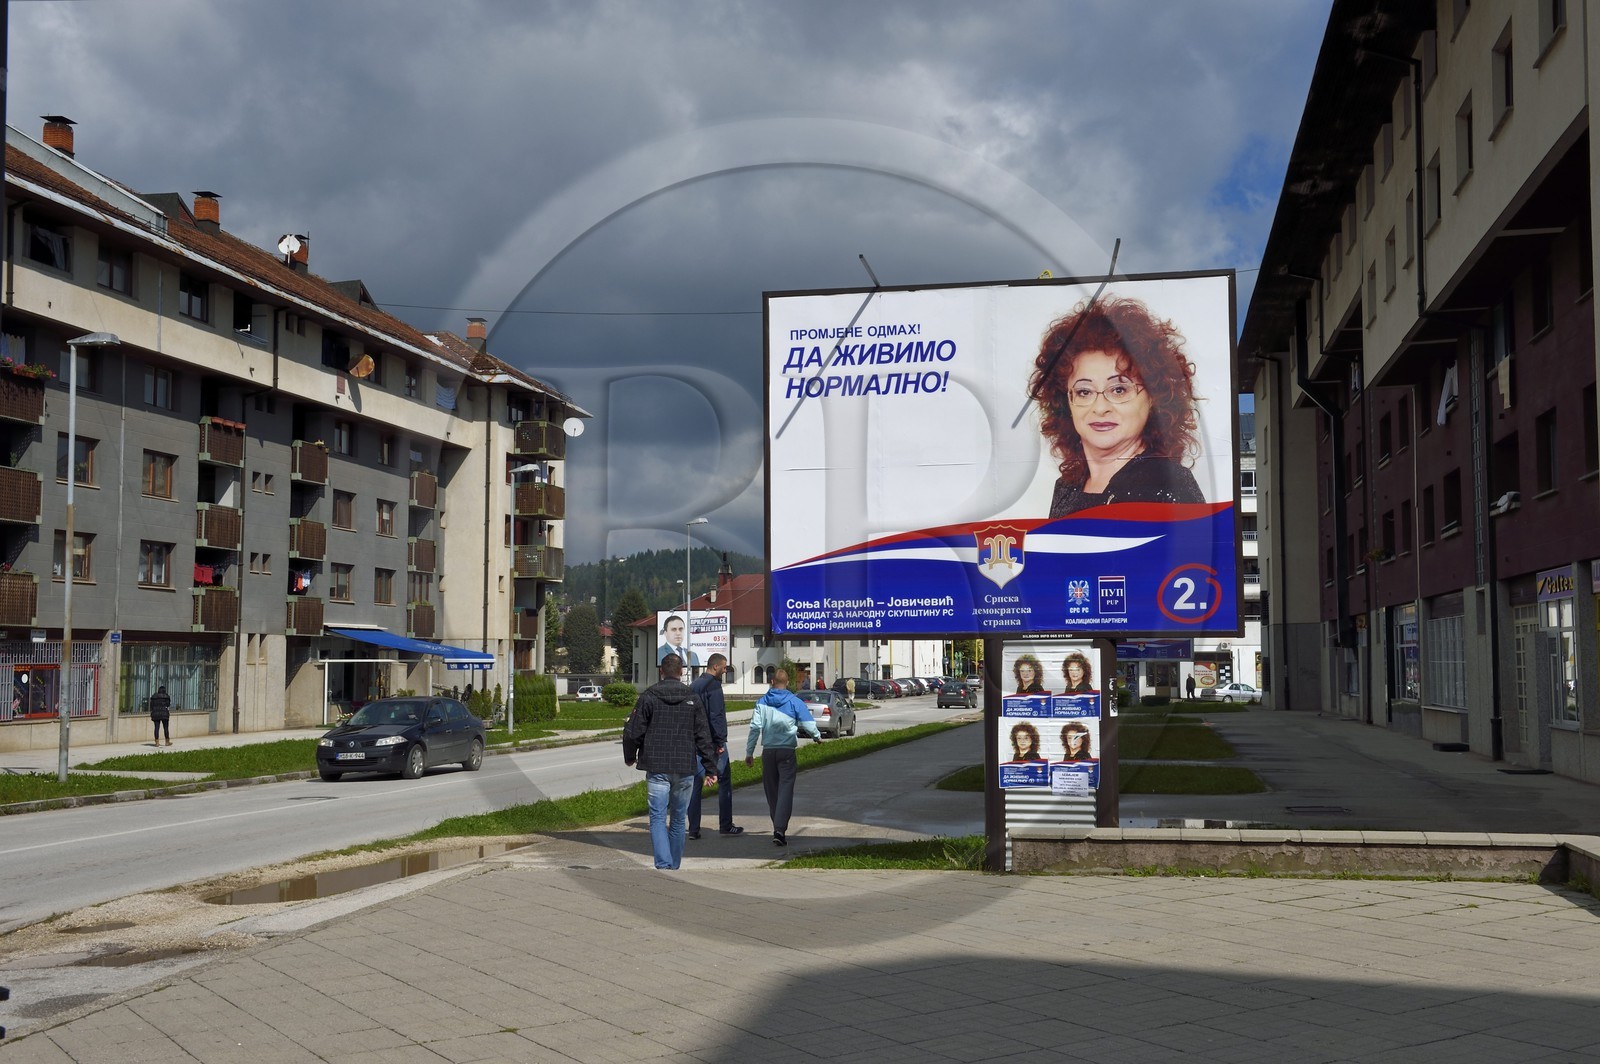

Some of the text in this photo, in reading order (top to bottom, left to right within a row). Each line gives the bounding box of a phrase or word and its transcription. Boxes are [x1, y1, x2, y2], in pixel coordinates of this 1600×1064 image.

[790, 324, 921, 341] ПРОМЈЕНЕ ОДМАХ!
[782, 339, 957, 374] ДА ЖИВИМО
[785, 371, 950, 399] НОРМАЛНО!
[1100, 588, 1124, 597] ПУП
[1173, 577, 1207, 610] 2.
[786, 598, 820, 609] Соња
[823, 597, 874, 611] Караџић
[887, 595, 954, 608] Јовичевић
[984, 594, 1019, 605] Српска
[786, 608, 954, 620] КАНДИДАТ ЗА НАРОДНУ СКУПШТИНУ РС
[972, 606, 1032, 616] демократска
[786, 619, 882, 631] Изборна јединица 8
[983, 618, 1021, 628] странка
